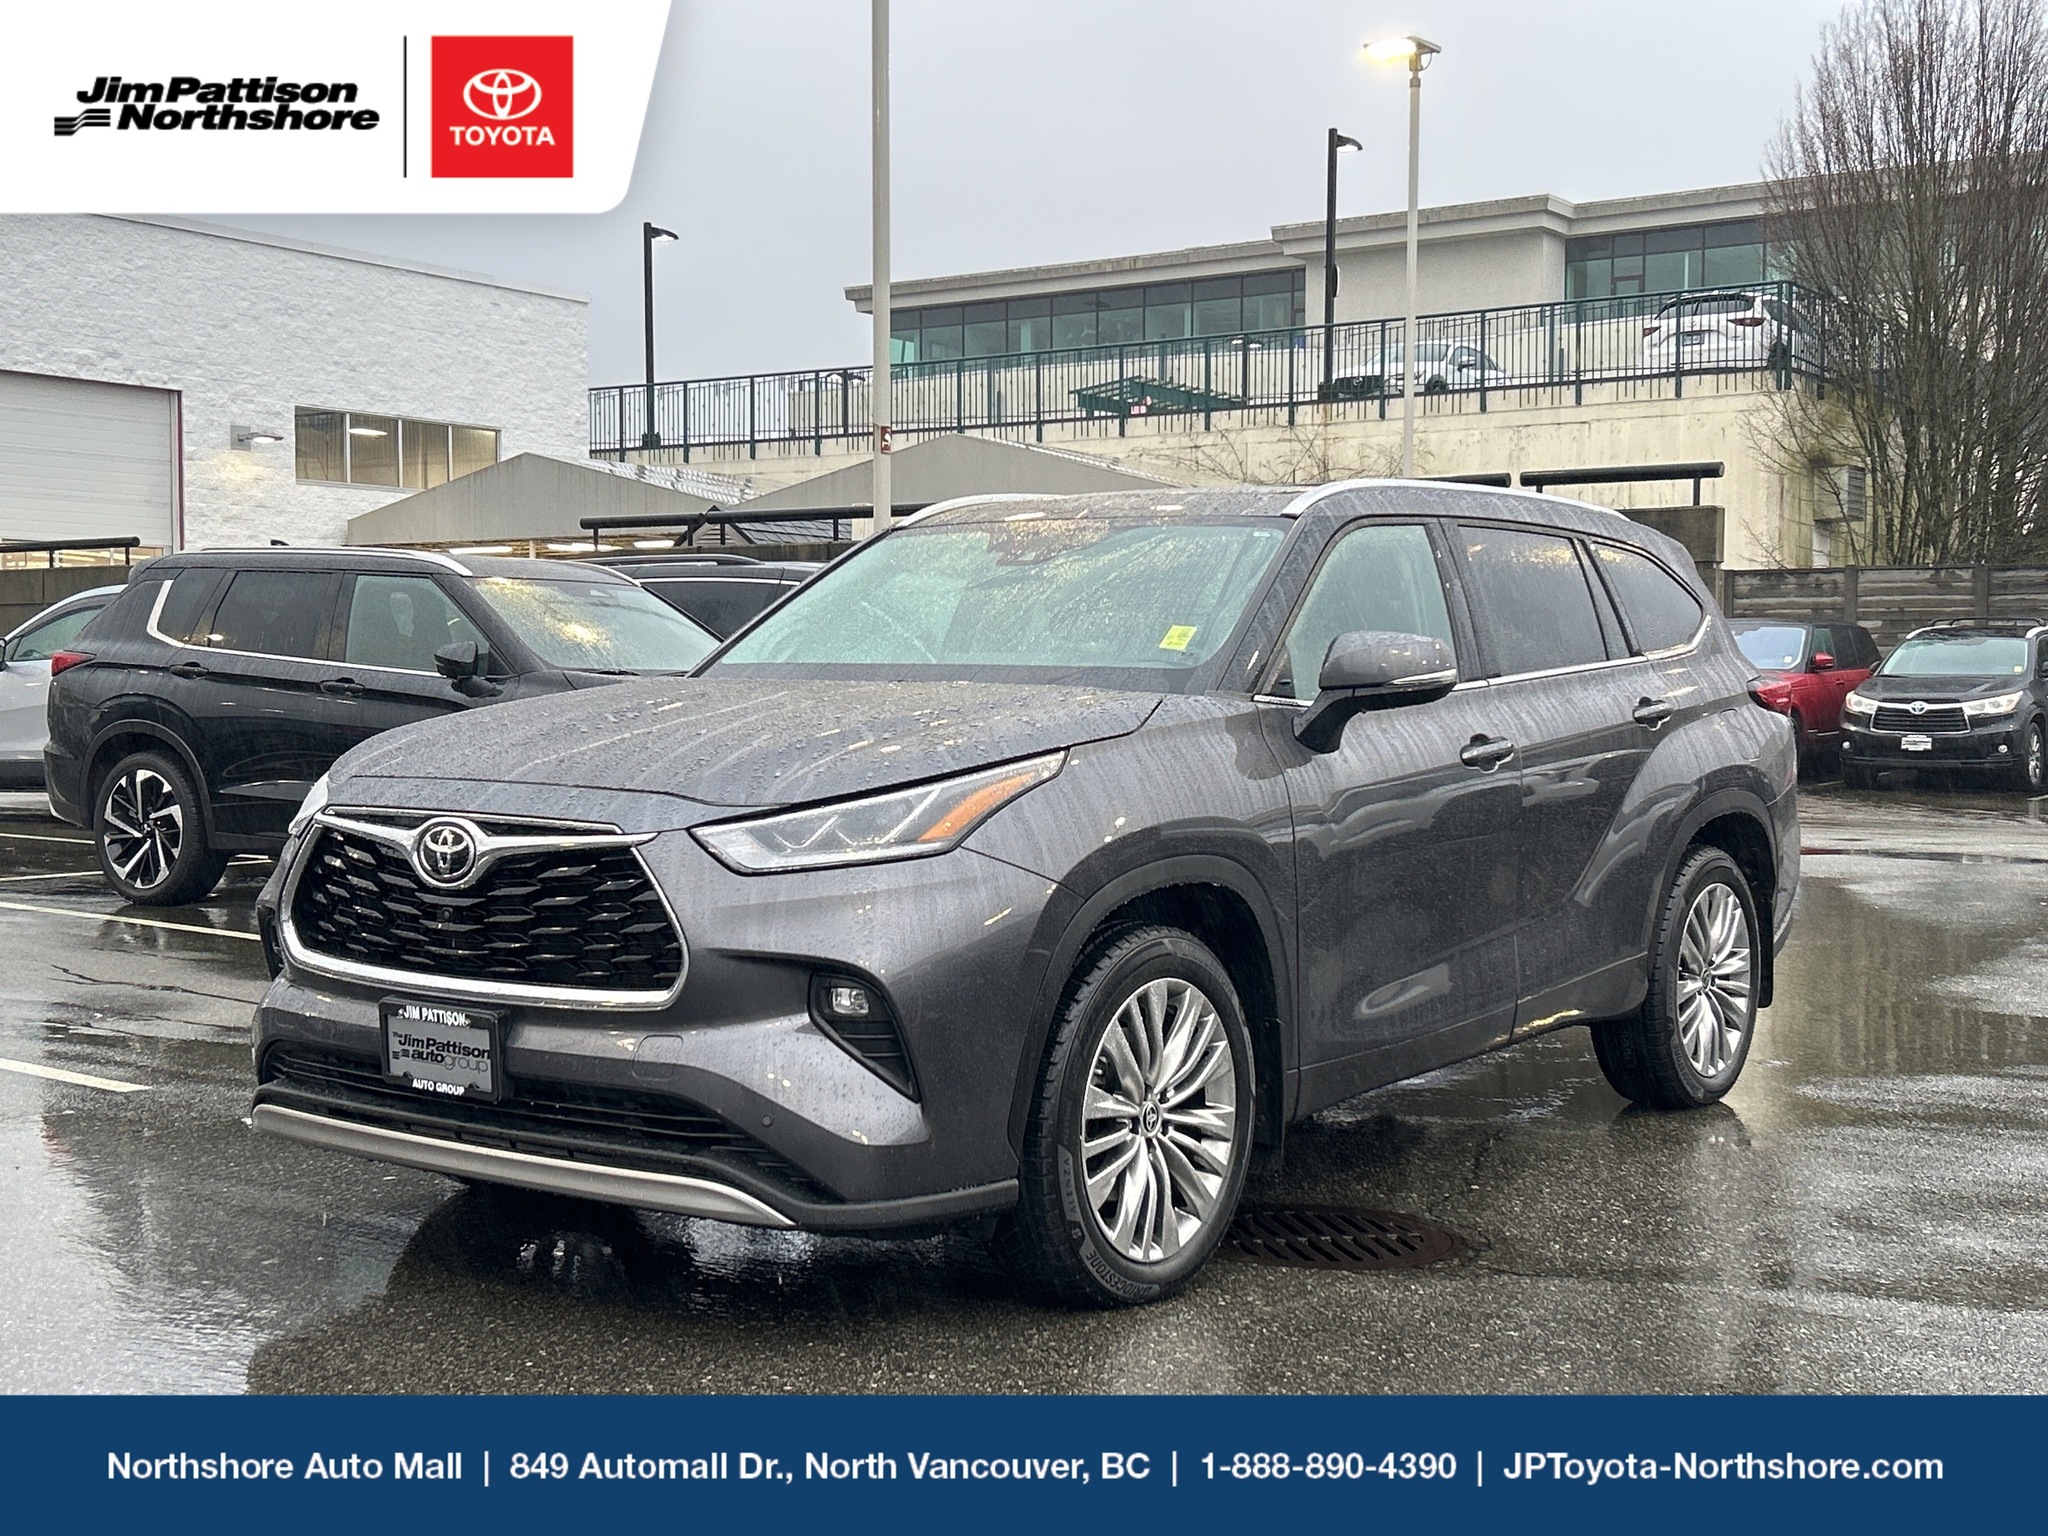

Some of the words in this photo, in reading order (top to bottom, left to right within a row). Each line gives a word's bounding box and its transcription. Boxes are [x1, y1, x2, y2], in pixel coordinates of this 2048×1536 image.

[403, 1005, 420, 1020] JIM
[421, 1008, 466, 1026] PATTISON
[412, 1078, 435, 1091] AUTO
[436, 1082, 465, 1096] GROUP
